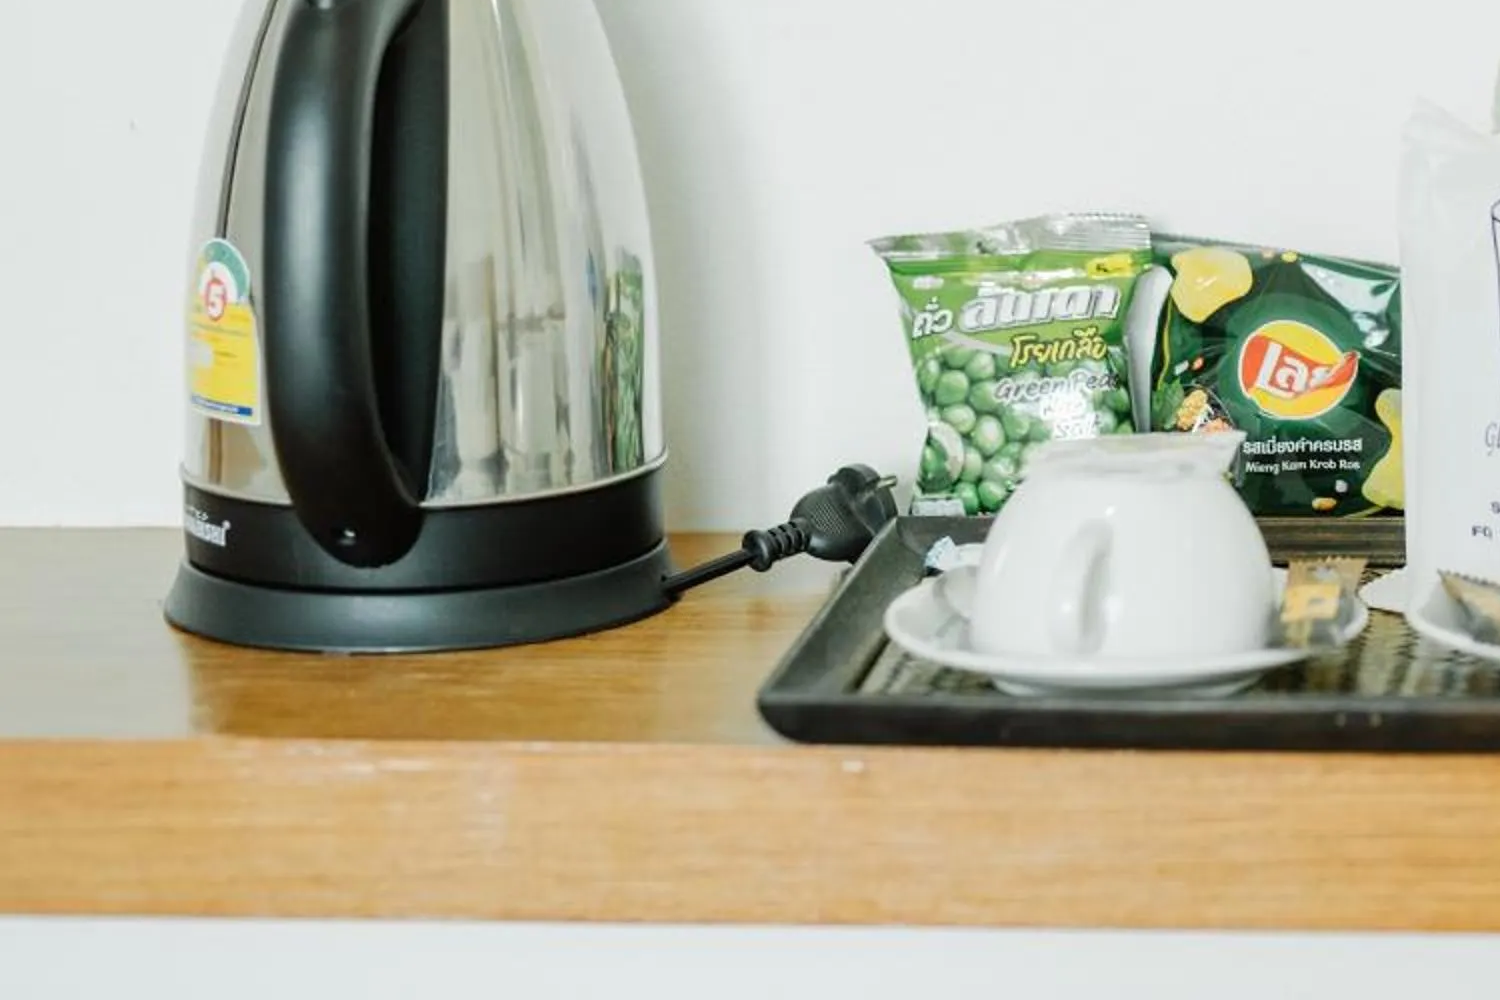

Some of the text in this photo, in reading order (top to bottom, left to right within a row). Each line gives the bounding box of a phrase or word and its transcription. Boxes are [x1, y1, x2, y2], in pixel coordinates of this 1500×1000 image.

[1009, 327, 1109, 368] โรยเกลือ
[994, 378, 1067, 400] Green
[1245, 459, 1361, 475] Mieng Kam Krob Ros
